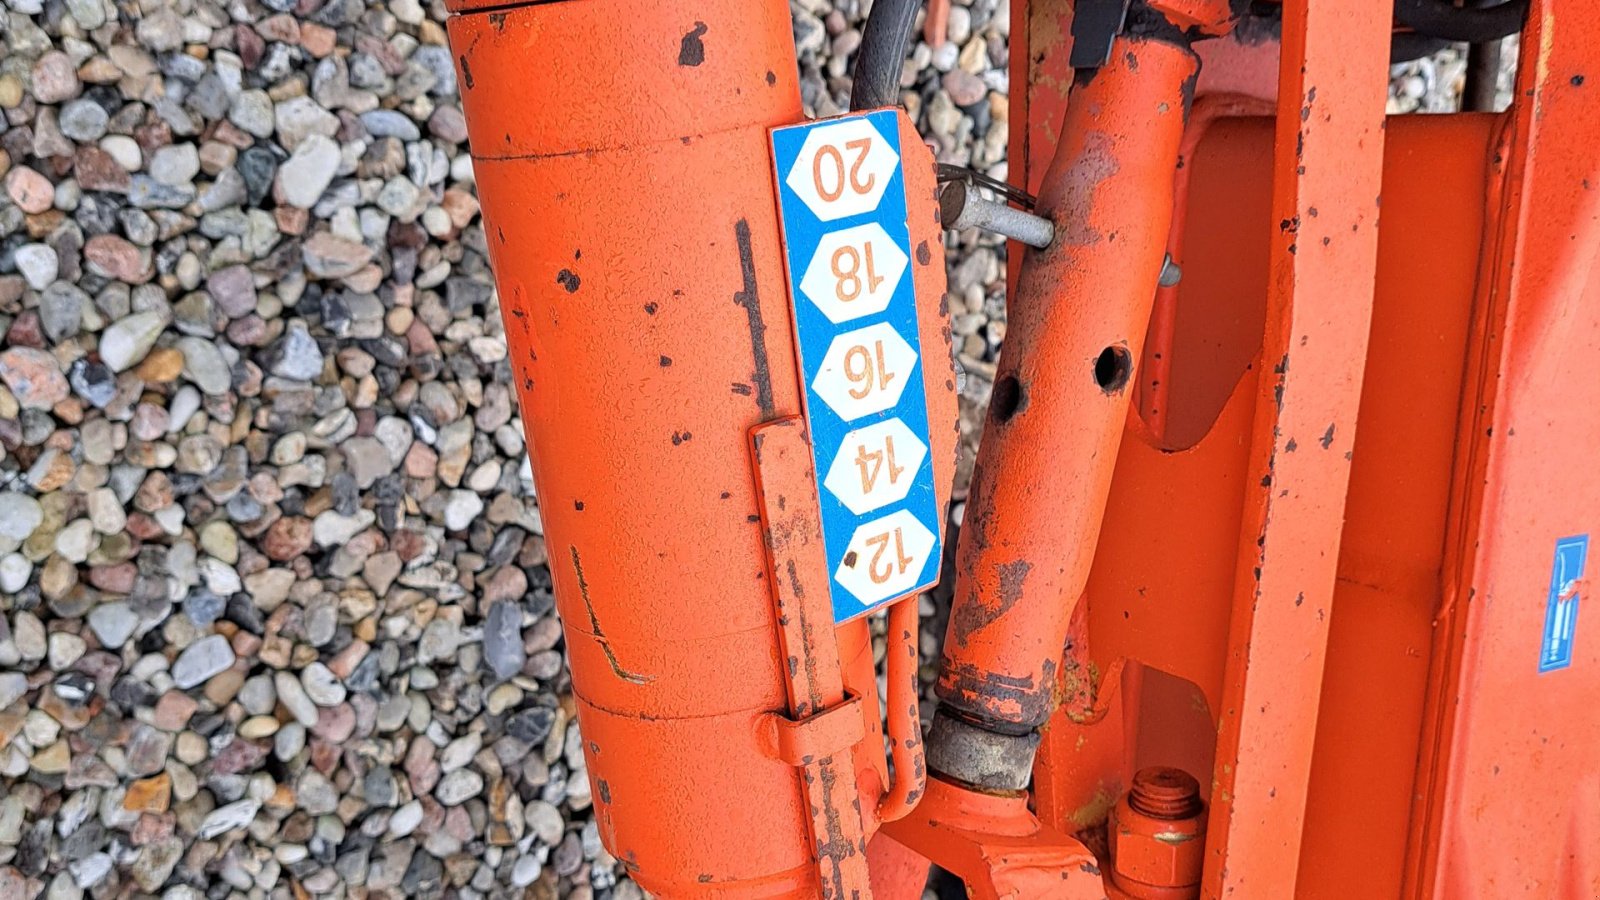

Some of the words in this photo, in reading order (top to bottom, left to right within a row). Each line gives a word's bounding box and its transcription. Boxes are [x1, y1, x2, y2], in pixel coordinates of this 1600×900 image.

[813, 138, 875, 202] 20
[831, 241, 884, 302] 18
[844, 341, 894, 400] 16
[855, 436, 904, 494] 14
[866, 528, 913, 584] 12
